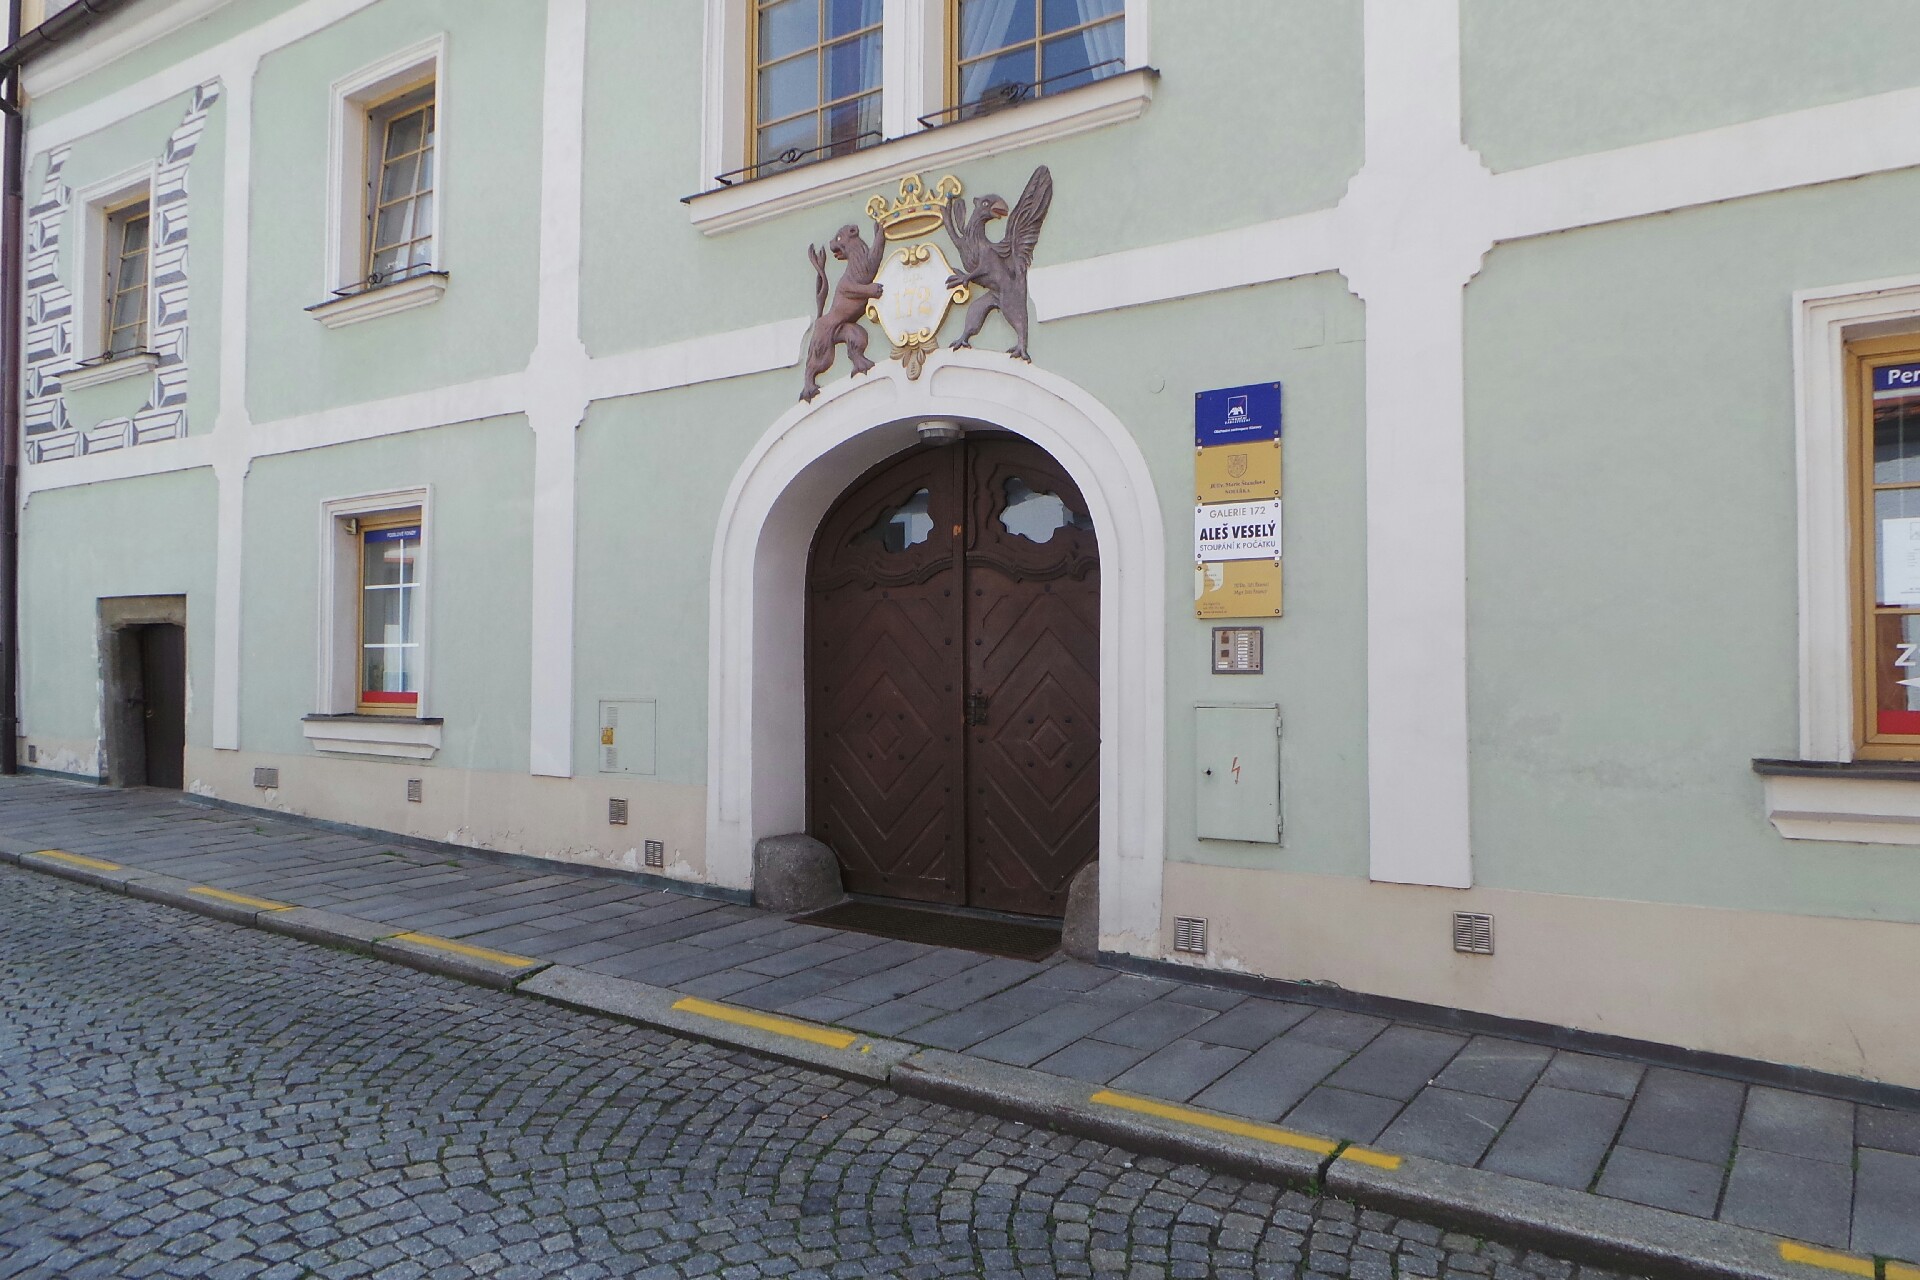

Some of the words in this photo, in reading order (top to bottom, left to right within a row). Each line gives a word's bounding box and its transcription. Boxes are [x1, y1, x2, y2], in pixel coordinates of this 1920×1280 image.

[895, 286, 932, 319] 172
[1209, 508, 1247, 519] GALERIE
[1250, 506, 1266, 516] 172
[1200, 523, 1229, 541] ALEŠ
[1232, 520, 1276, 539] VESELÝ
[1200, 542, 1235, 552] STOUPÁNÍ
[1242, 540, 1276, 549] POČÁTKU
